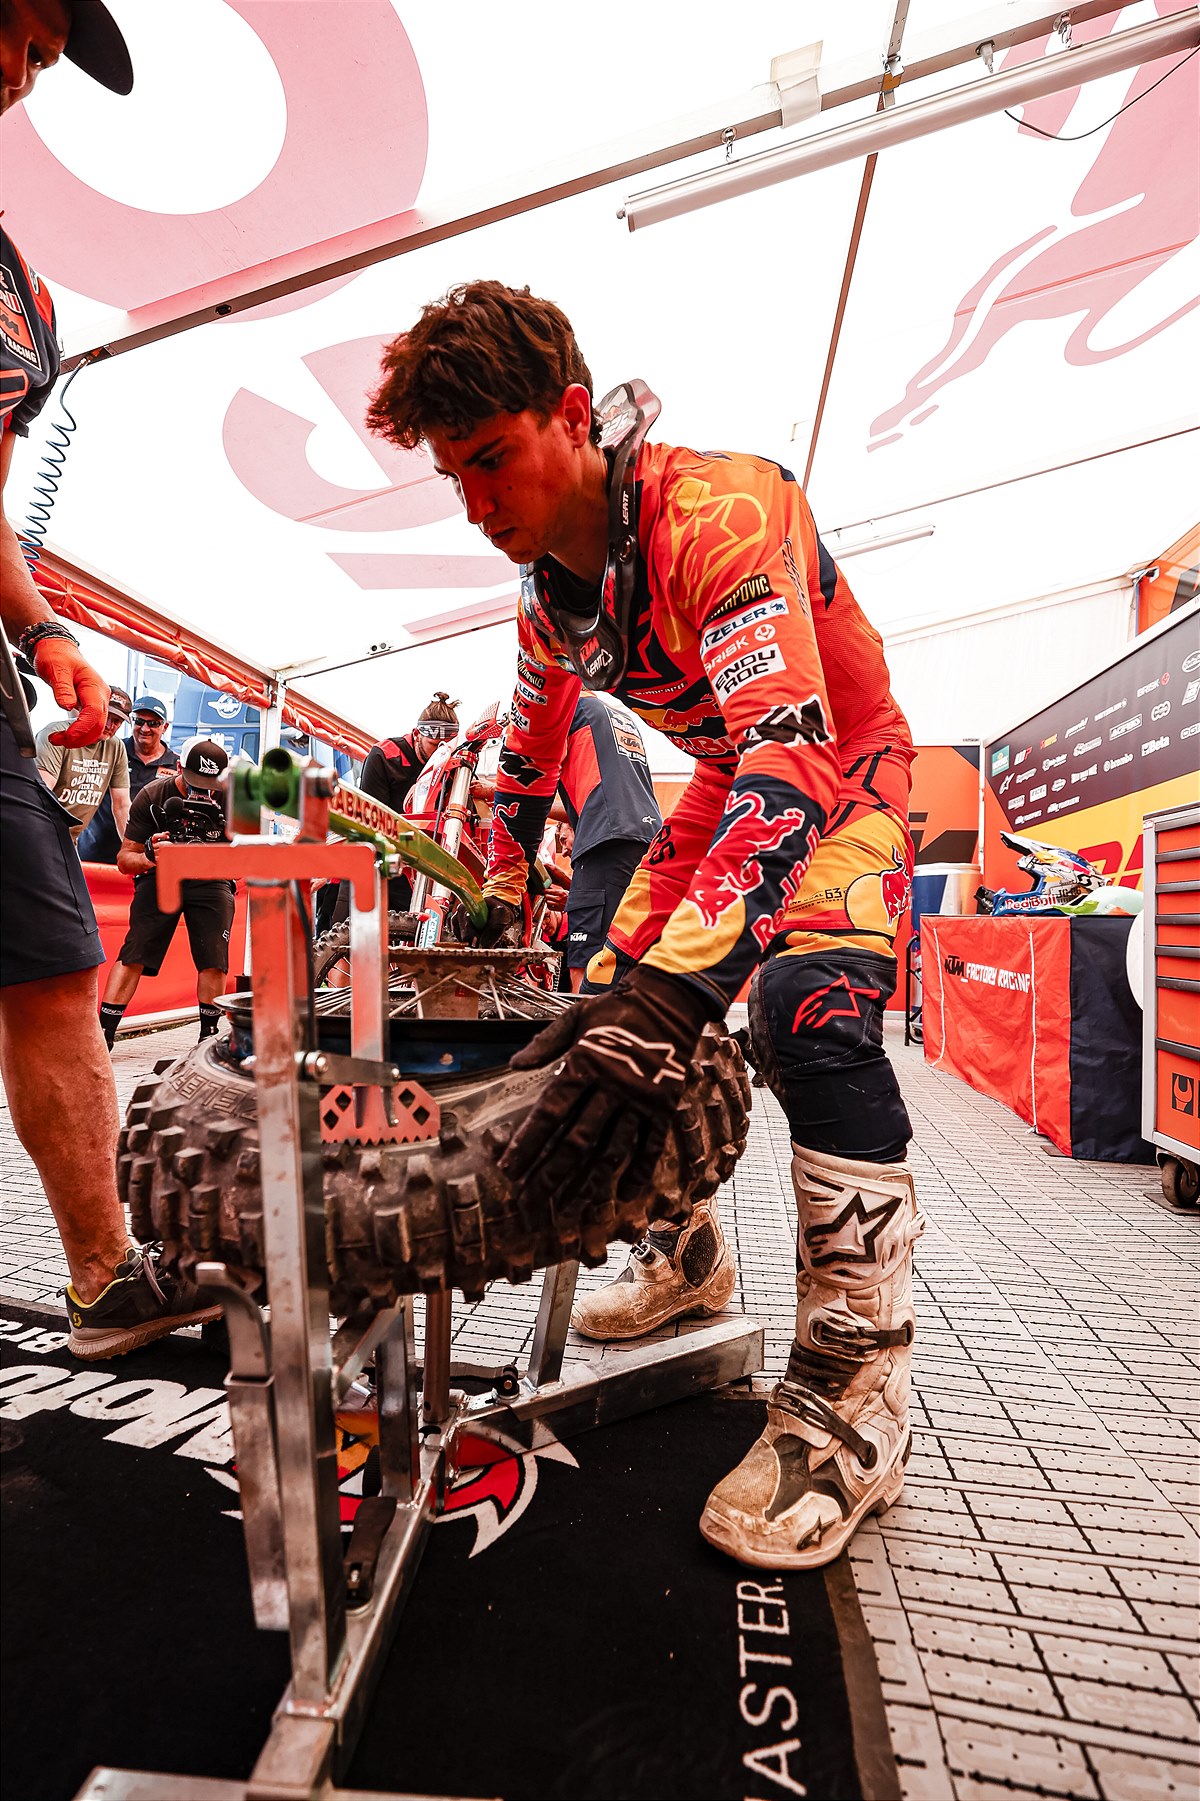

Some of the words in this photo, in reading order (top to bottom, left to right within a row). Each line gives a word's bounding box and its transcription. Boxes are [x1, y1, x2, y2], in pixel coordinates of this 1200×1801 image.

[9, 339, 37, 362] RACING
[715, 650, 776, 691] ENDU
[725, 662, 769, 694] ROC
[58, 789, 103, 806] DUCATI
[330, 788, 400, 842] ABACONDA
[824, 887, 843, 899] 63
[1005, 897, 1031, 910] Red
[1031, 894, 1057, 907] Bull
[570, 932, 587, 942] KTM
[944, 955, 964, 976] KTM
[736, 1577, 807, 1801] ASTER.
